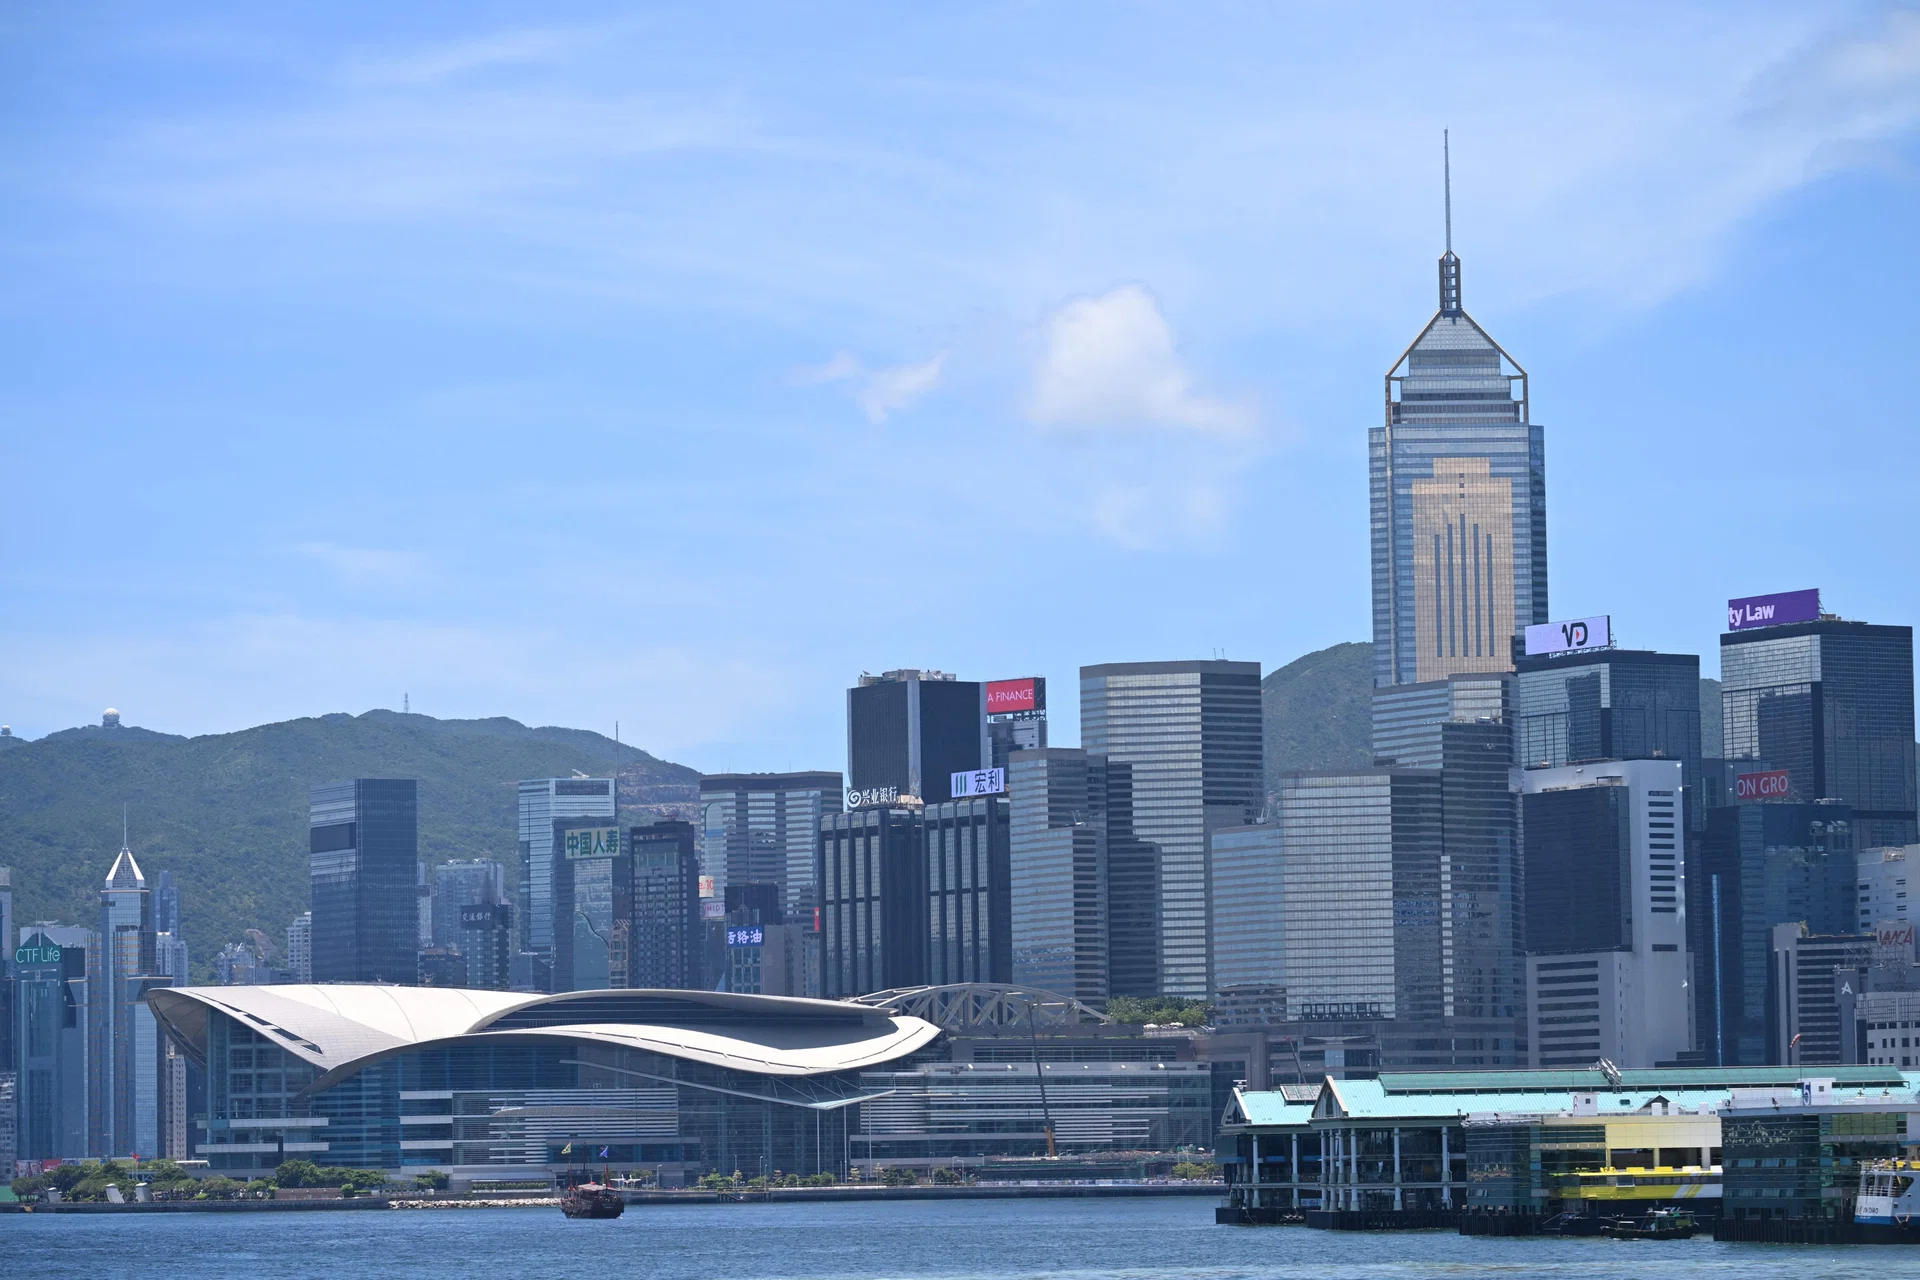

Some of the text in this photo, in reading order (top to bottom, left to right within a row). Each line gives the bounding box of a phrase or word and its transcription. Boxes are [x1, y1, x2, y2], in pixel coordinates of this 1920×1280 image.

[1729, 603, 1776, 626] ty Law
[987, 688, 1033, 703] A FINANCE
[975, 769, 1000, 793] 宏利
[1737, 775, 1788, 796] ON GRO
[861, 786, 898, 805] 兴业银行
[16, 947, 60, 963] CTF Life
